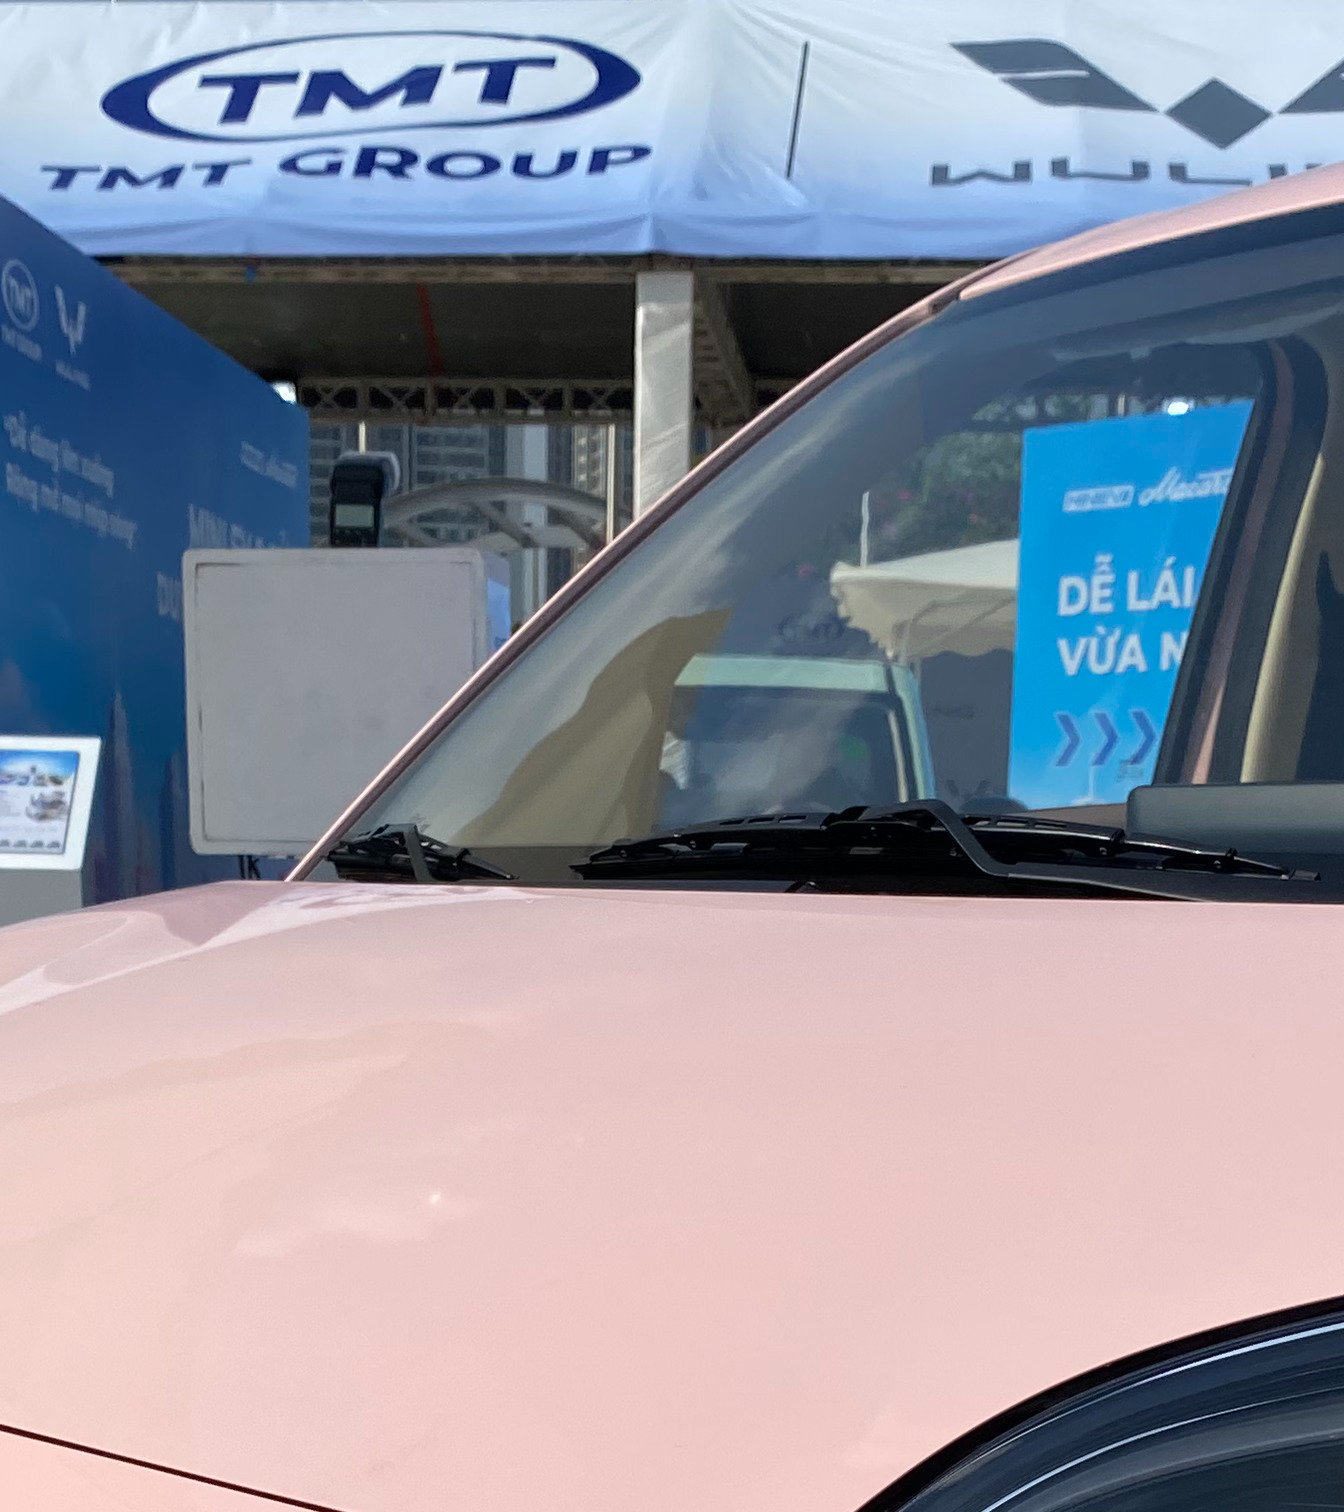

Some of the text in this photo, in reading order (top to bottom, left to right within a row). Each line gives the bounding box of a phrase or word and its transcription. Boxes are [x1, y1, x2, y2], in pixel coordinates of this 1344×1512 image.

[198, 57, 558, 126] TMT
[40, 145, 653, 191] TMT GROUP
[1057, 551, 1197, 617] DỄ LÁI
[1057, 624, 1148, 676] VỪA
